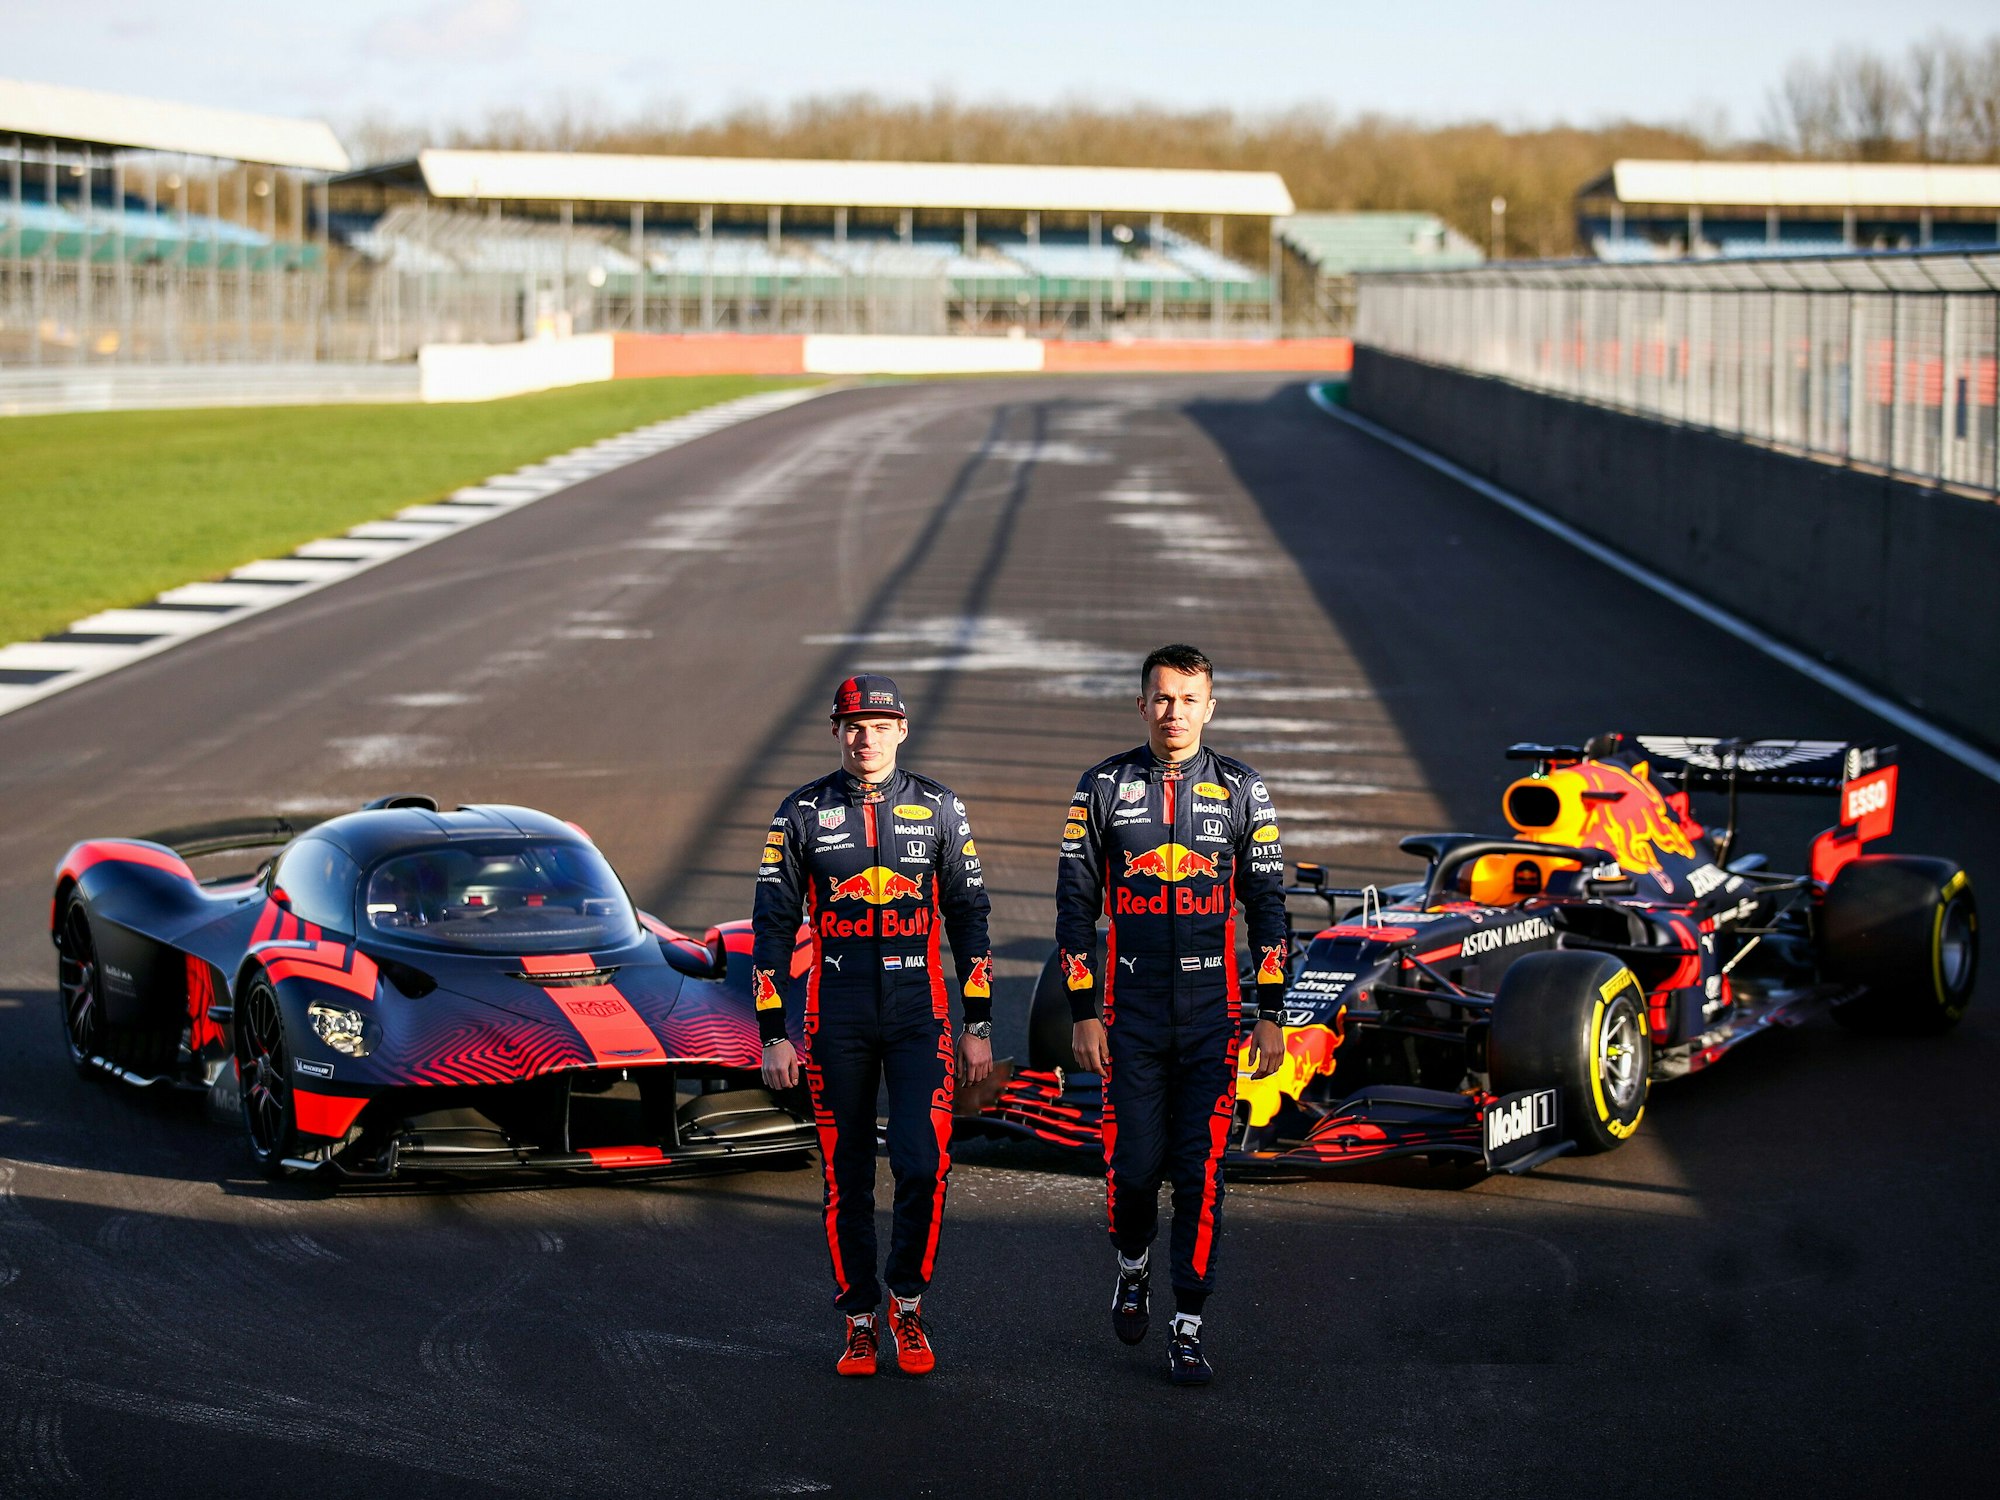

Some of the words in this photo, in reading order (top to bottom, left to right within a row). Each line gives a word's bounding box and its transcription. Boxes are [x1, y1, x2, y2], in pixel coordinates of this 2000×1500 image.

[821, 807, 844, 818] TAG
[904, 808, 927, 816] RAUCH
[1192, 803, 1221, 814] Mobil
[1848, 780, 1887, 819] ESSO
[895, 825, 924, 835] Mobil
[1196, 835, 1227, 843] HONDA
[815, 845, 832, 853] ASTON
[1117, 885, 1168, 915] Red
[1176, 885, 1225, 915] Bull
[821, 908, 874, 938] Red
[882, 908, 928, 938] Bull
[1461, 927, 1503, 958] ASTON
[905, 956, 925, 968] MAX
[1204, 956, 1222, 968] ALEX
[932, 1004, 955, 1056] Bull
[931, 1050, 956, 1111] Red
[1214, 1057, 1238, 1116] Red
[806, 1070, 836, 1127] Bull
[1489, 1095, 1532, 1150] Mobil
